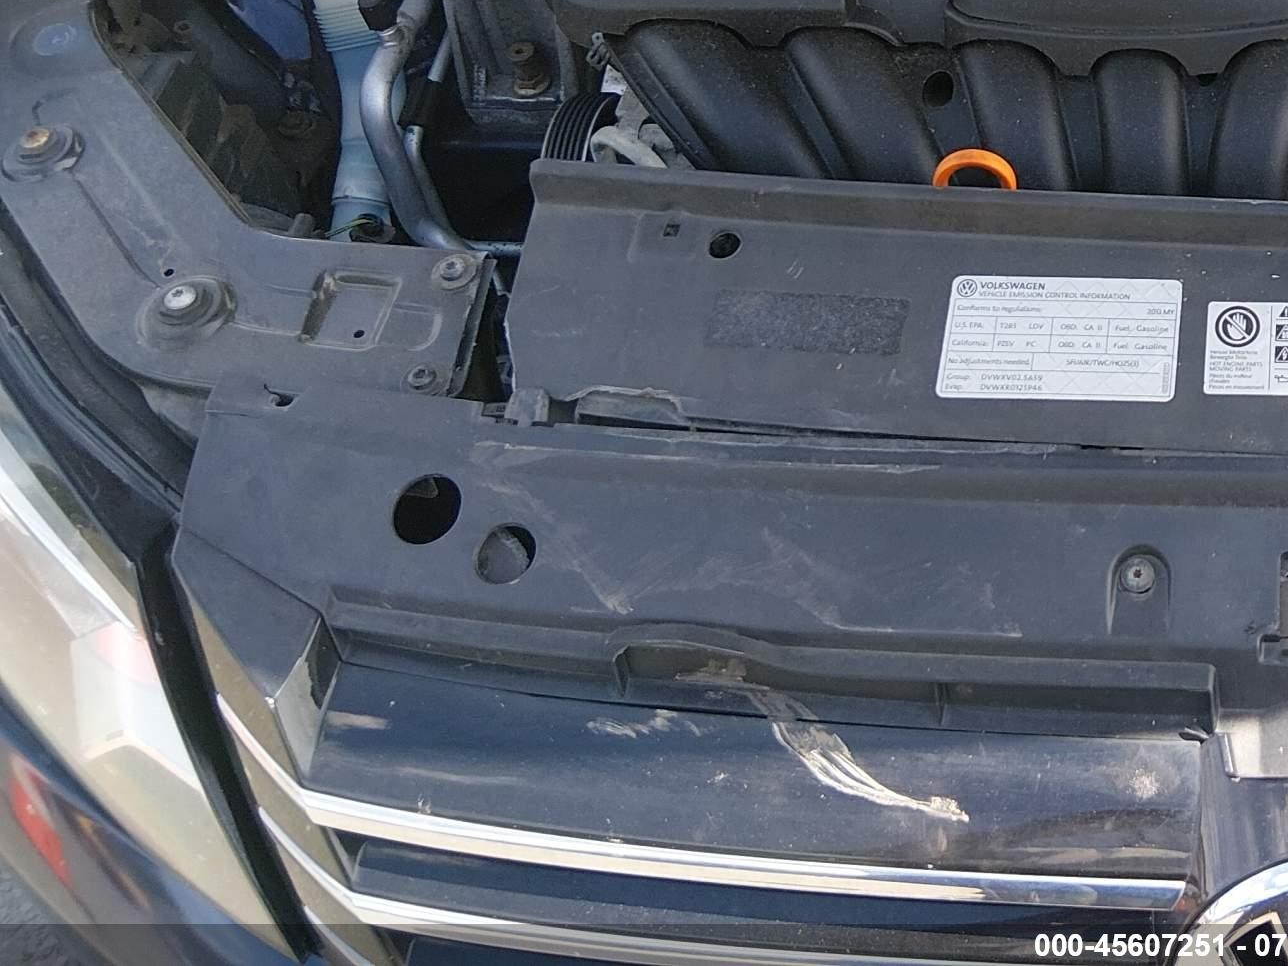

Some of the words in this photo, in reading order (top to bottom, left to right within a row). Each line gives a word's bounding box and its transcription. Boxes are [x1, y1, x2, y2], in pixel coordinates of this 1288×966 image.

[980, 281, 1047, 291] VOLKSWAGEN
[1045, 292, 1077, 300] CONTROL
[1079, 292, 1131, 300] INFORMATION
[1028, 322, 1045, 330] LDV
[1083, 323, 1095, 331] CA
[1136, 324, 1169, 335] Gasoline
[1134, 342, 1168, 351] Gasoline
